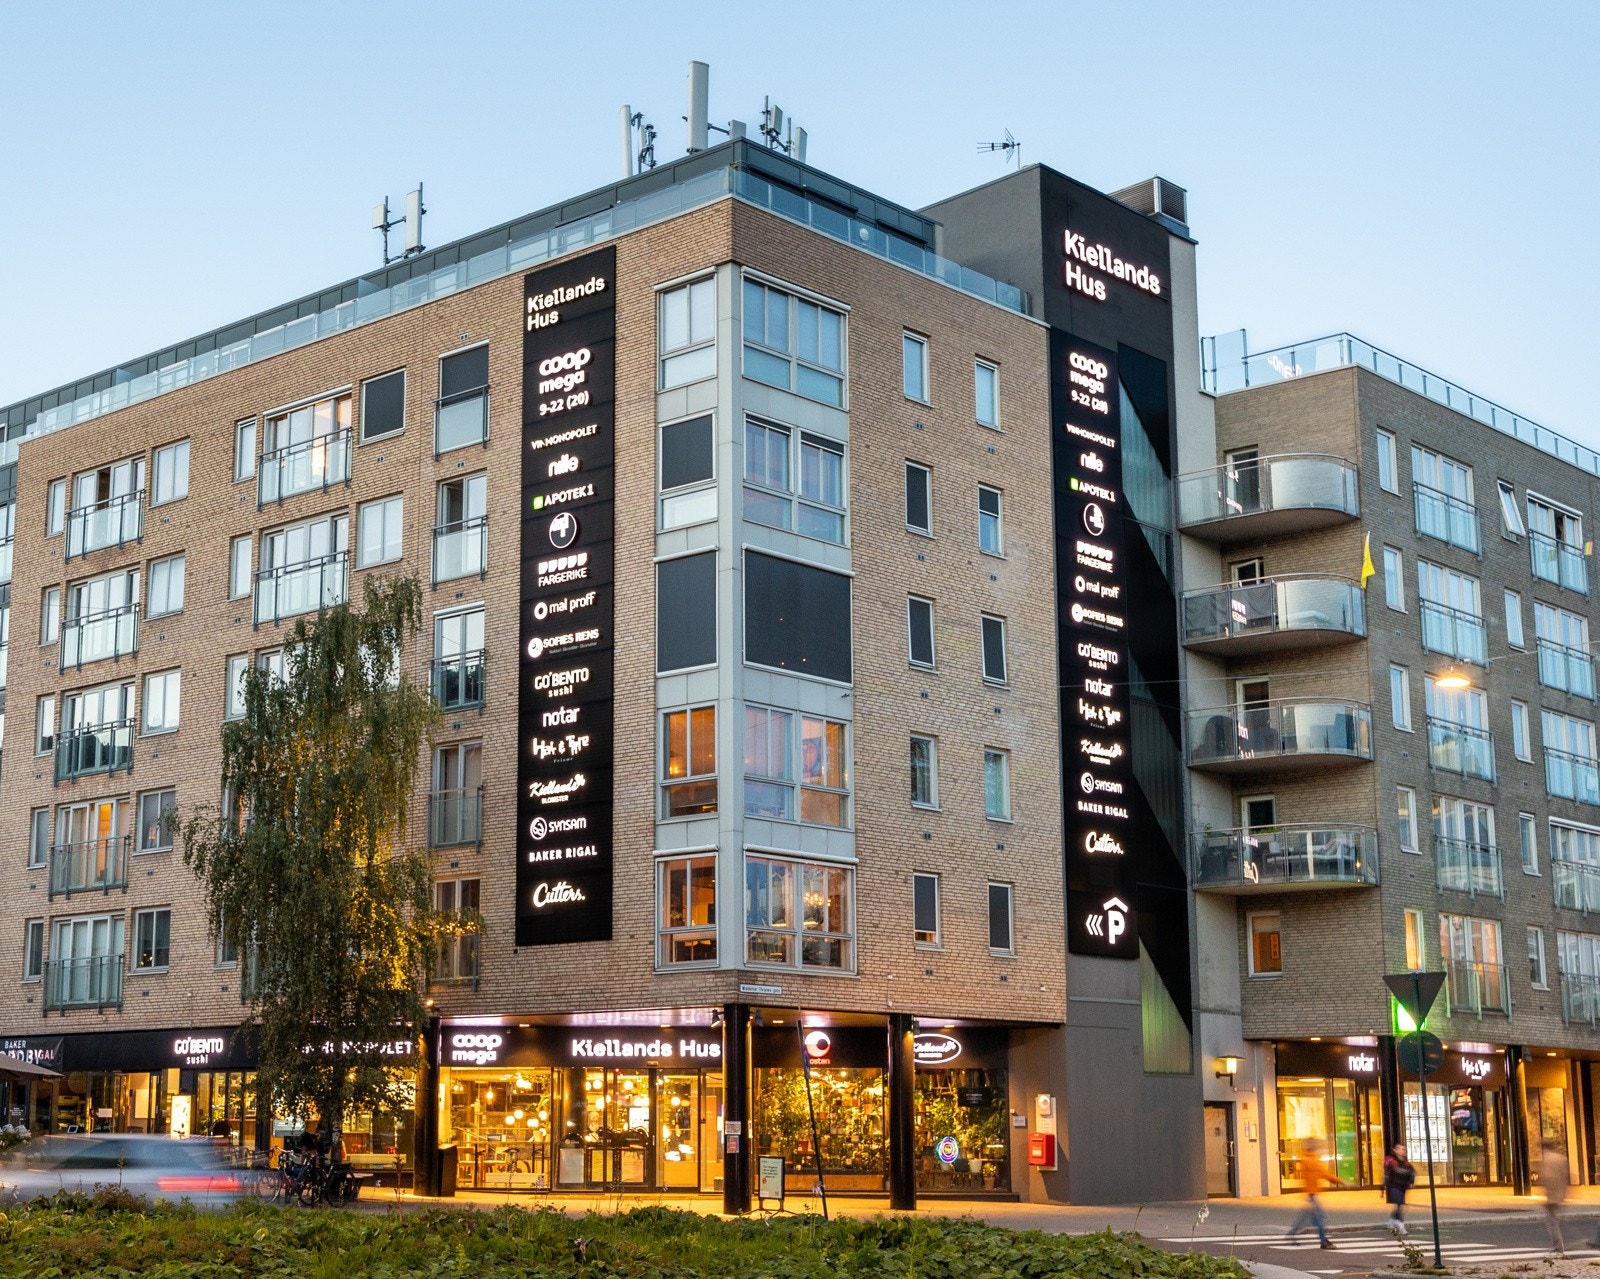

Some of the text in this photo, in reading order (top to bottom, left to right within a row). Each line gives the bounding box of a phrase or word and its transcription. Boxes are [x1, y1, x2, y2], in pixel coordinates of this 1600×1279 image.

[1064, 229, 1161, 295] Kiellands
[1065, 260, 1107, 301] Hus
[526, 276, 605, 314] Kiellands
[526, 310, 559, 331] Hus
[538, 347, 591, 377] coop
[538, 369, 586, 394] mega
[1070, 369, 1105, 395] mega
[539, 390, 590, 416] 9-22 (20)
[548, 454, 579, 477] nille
[544, 488, 586, 507] APOTEK
[538, 567, 588, 587] FARGERIKE
[549, 591, 597, 614] mal proff
[542, 633, 575, 649] SOFIES
[575, 628, 600, 643] RENS
[548, 684, 573, 698] sushi
[1084, 678, 1113, 697] notar
[542, 706, 580, 727] notar
[1077, 801, 1129, 819] BAKER RIGAL
[529, 845, 598, 863] BAKER RIGAL
[1107, 909, 1127, 945] P
[4, 1039, 27, 1049] BAKER
[452, 1034, 503, 1051] coop
[571, 1039, 721, 1058] Kiellands Hus
[186, 1054, 209, 1065] sushi
[452, 1050, 497, 1065] mega
[1348, 1052, 1375, 1072] notar
